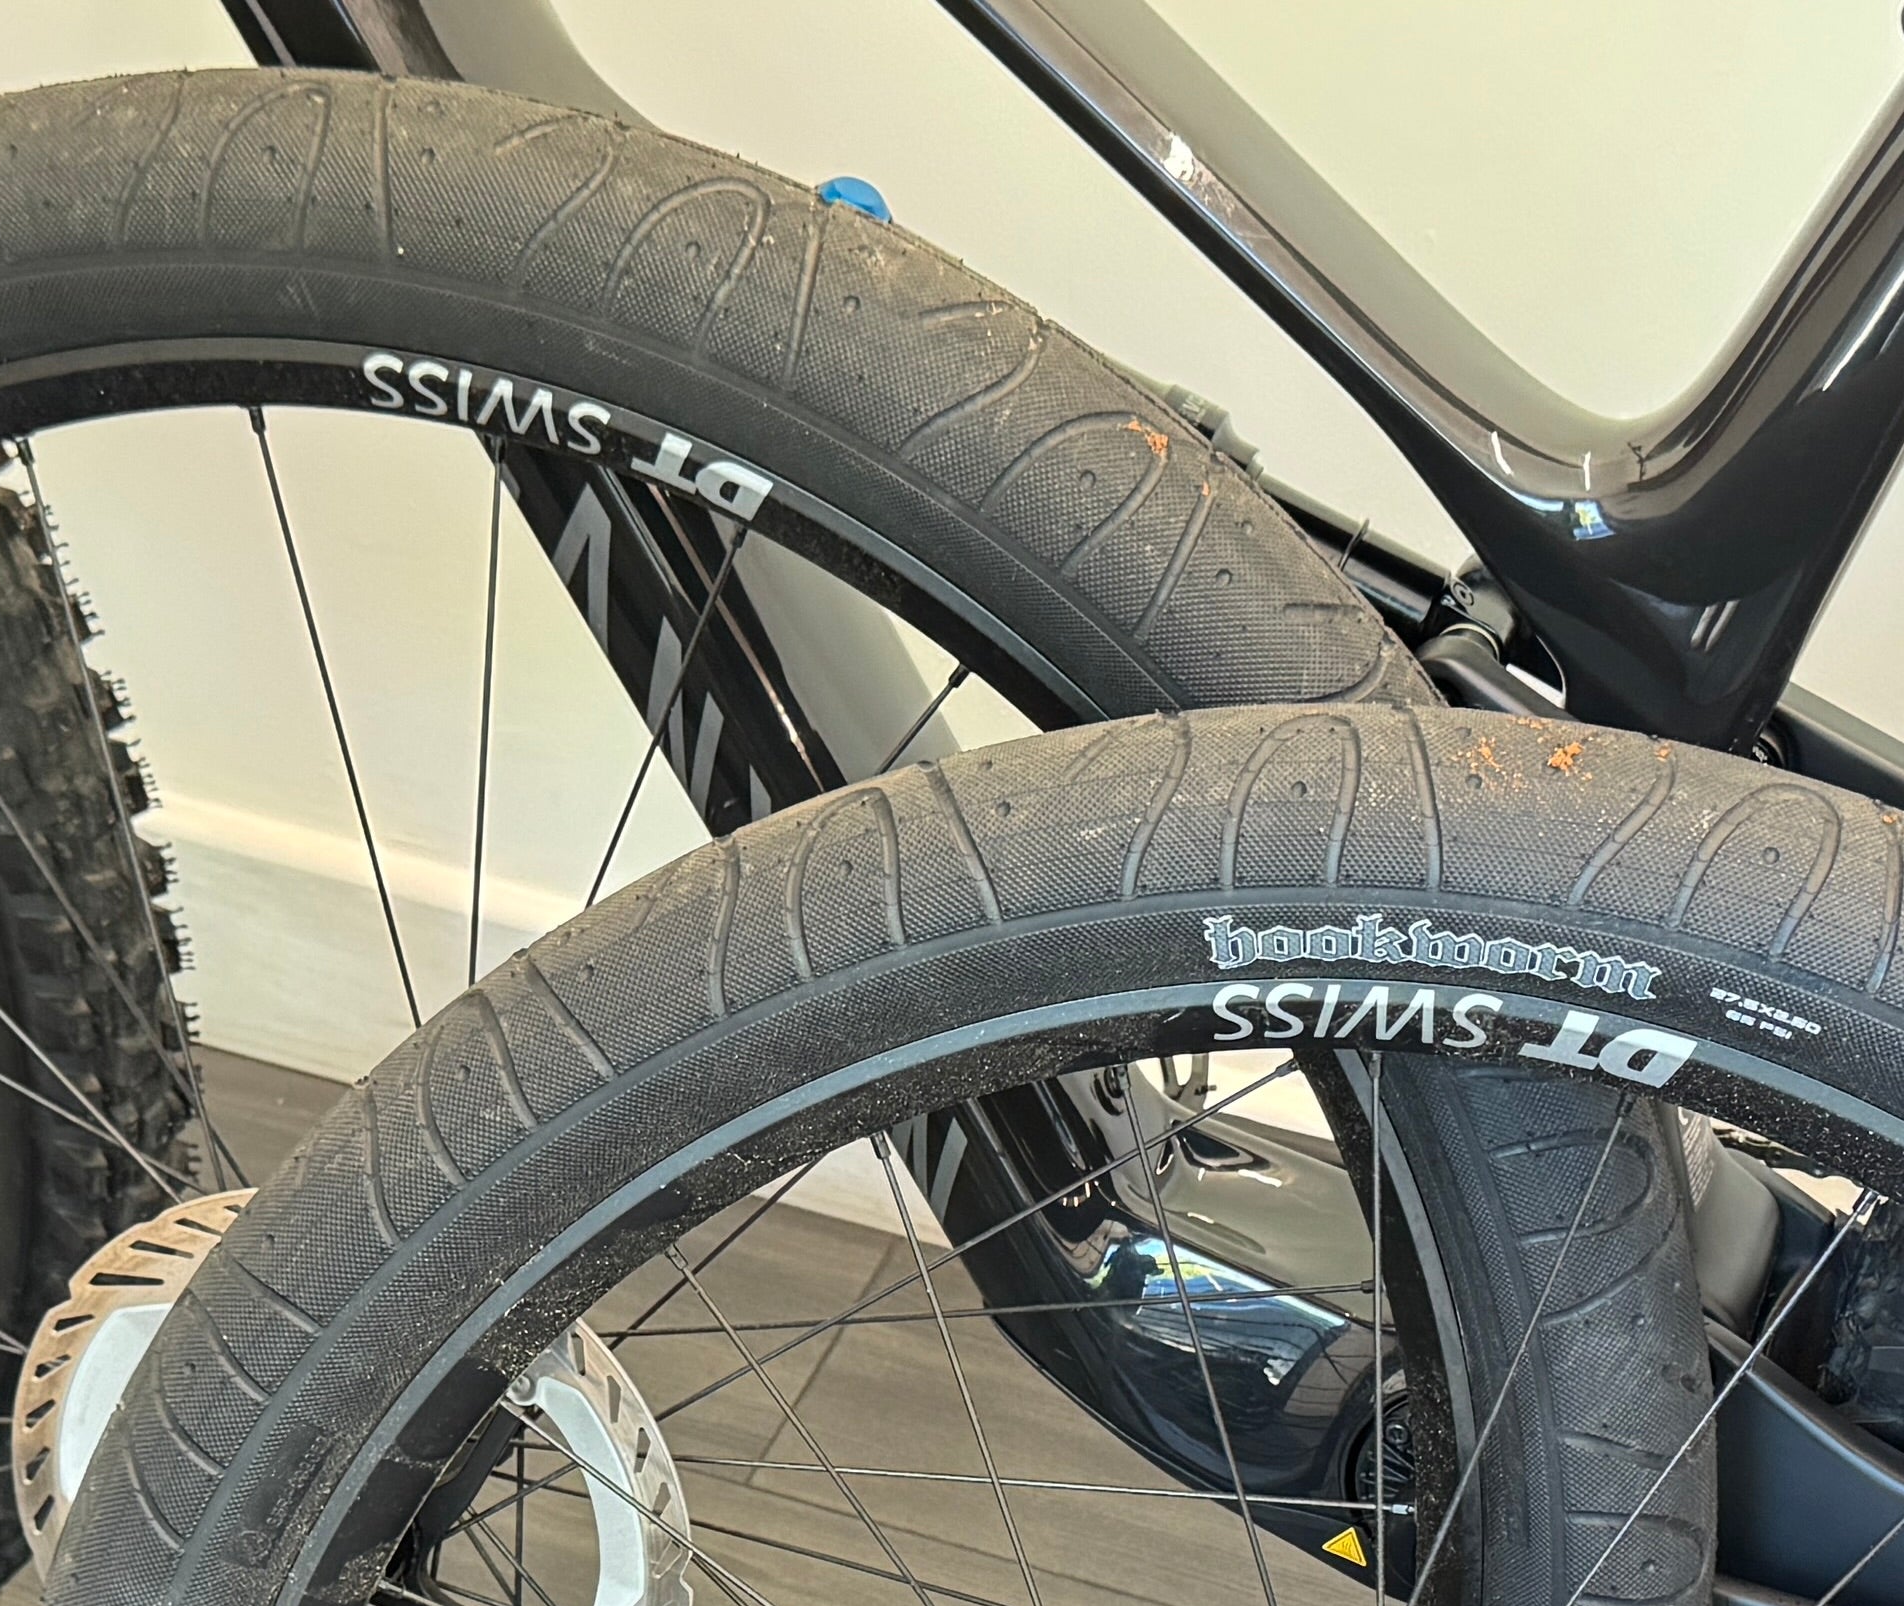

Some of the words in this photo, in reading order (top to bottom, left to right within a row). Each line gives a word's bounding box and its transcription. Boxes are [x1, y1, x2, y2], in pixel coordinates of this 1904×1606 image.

[362, 352, 612, 455] SWISS
[631, 433, 774, 521] DT
[1203, 913, 1662, 1002] hookworm
[1211, 982, 1505, 1051] SWISS
[1516, 1007, 1699, 1090] DT
